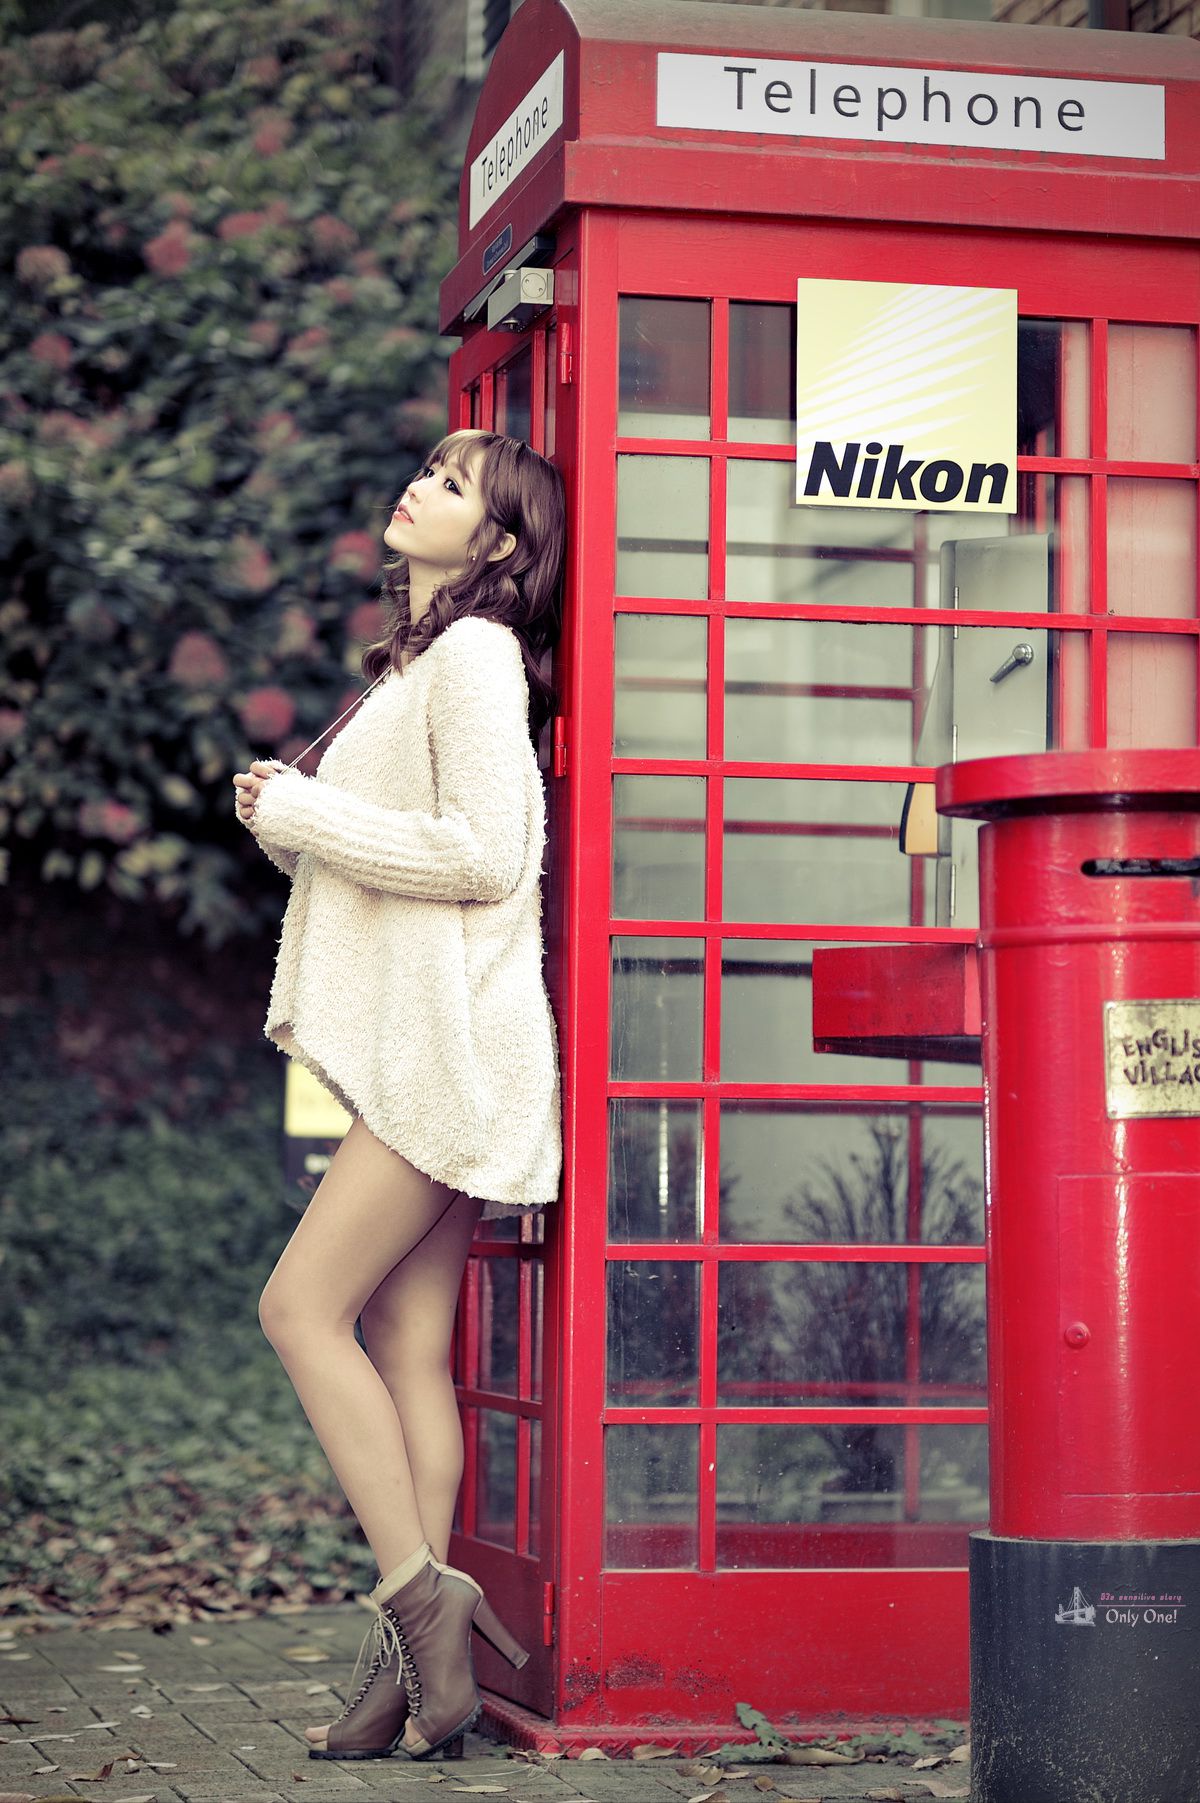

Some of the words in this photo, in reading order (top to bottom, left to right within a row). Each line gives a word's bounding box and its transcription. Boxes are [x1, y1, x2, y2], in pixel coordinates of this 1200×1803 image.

[723, 65, 1086, 132] Telephone
[481, 96, 548, 198] Telephone
[803, 441, 1009, 504] Nikon
